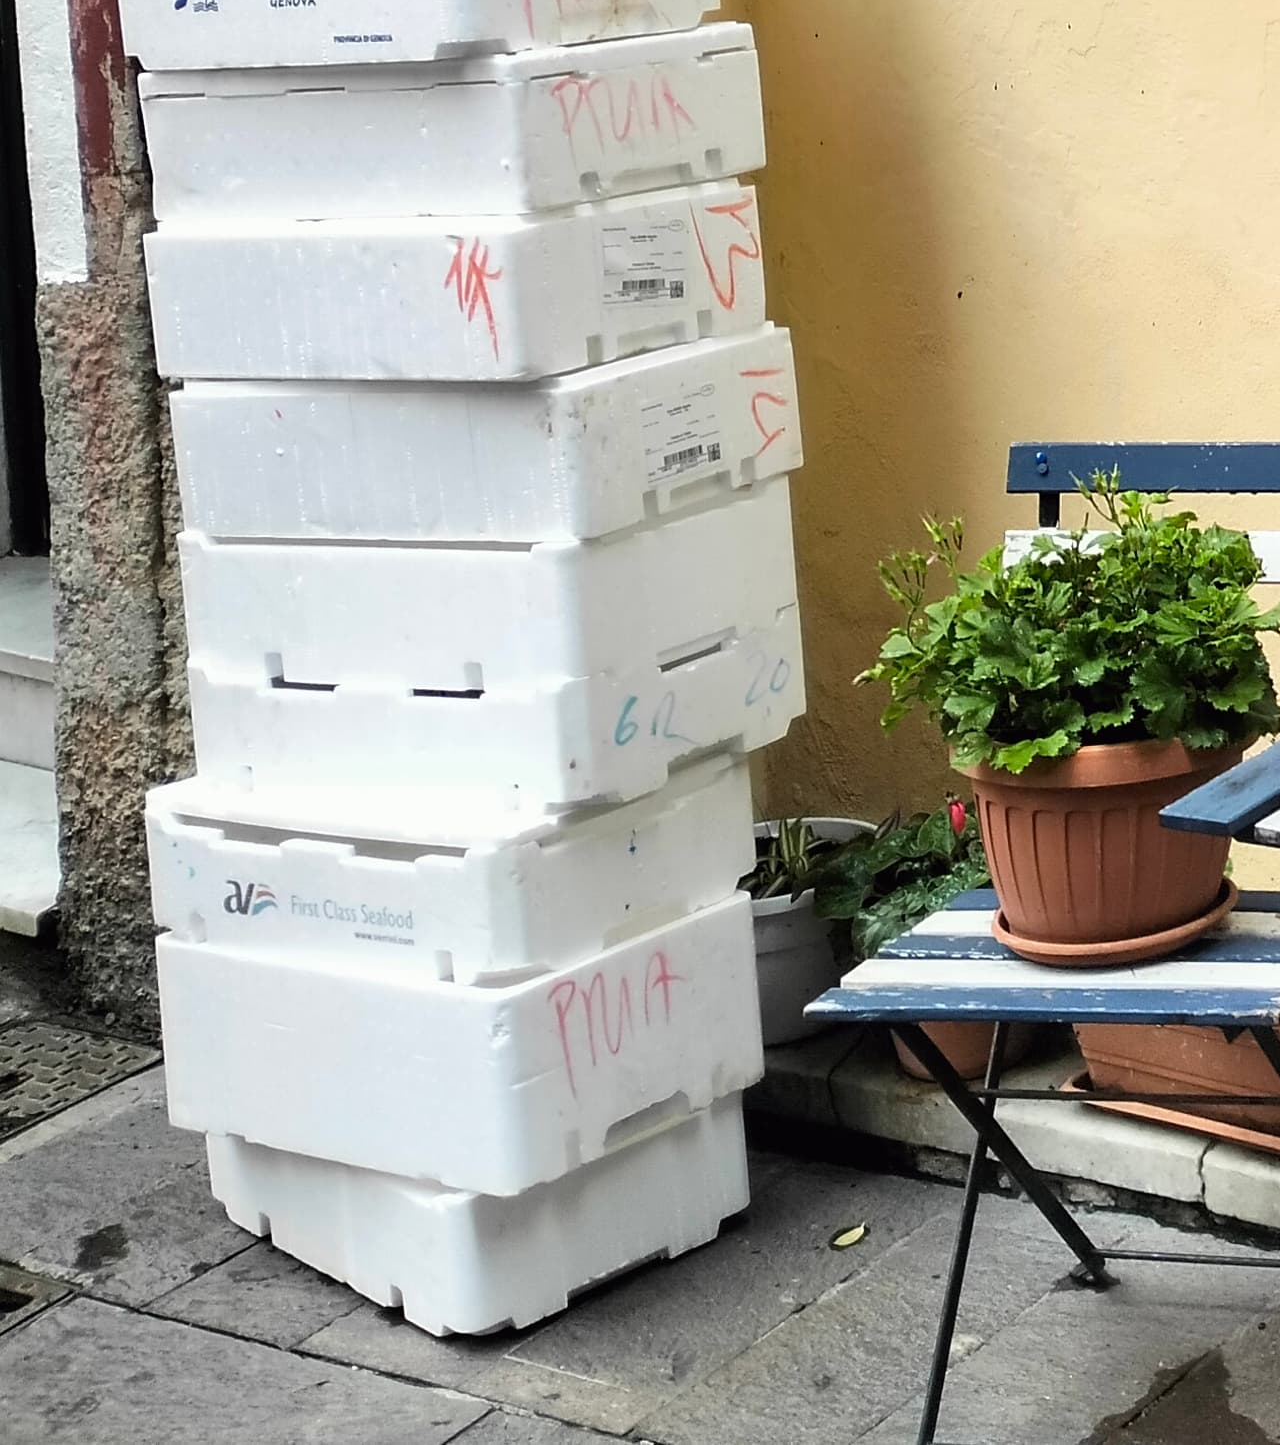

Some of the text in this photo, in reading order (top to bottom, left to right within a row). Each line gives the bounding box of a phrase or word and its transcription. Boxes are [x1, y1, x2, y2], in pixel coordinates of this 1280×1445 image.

[290, 895, 320, 917] First
[323, 899, 357, 923] Class
[360, 904, 414, 930] Seafood
